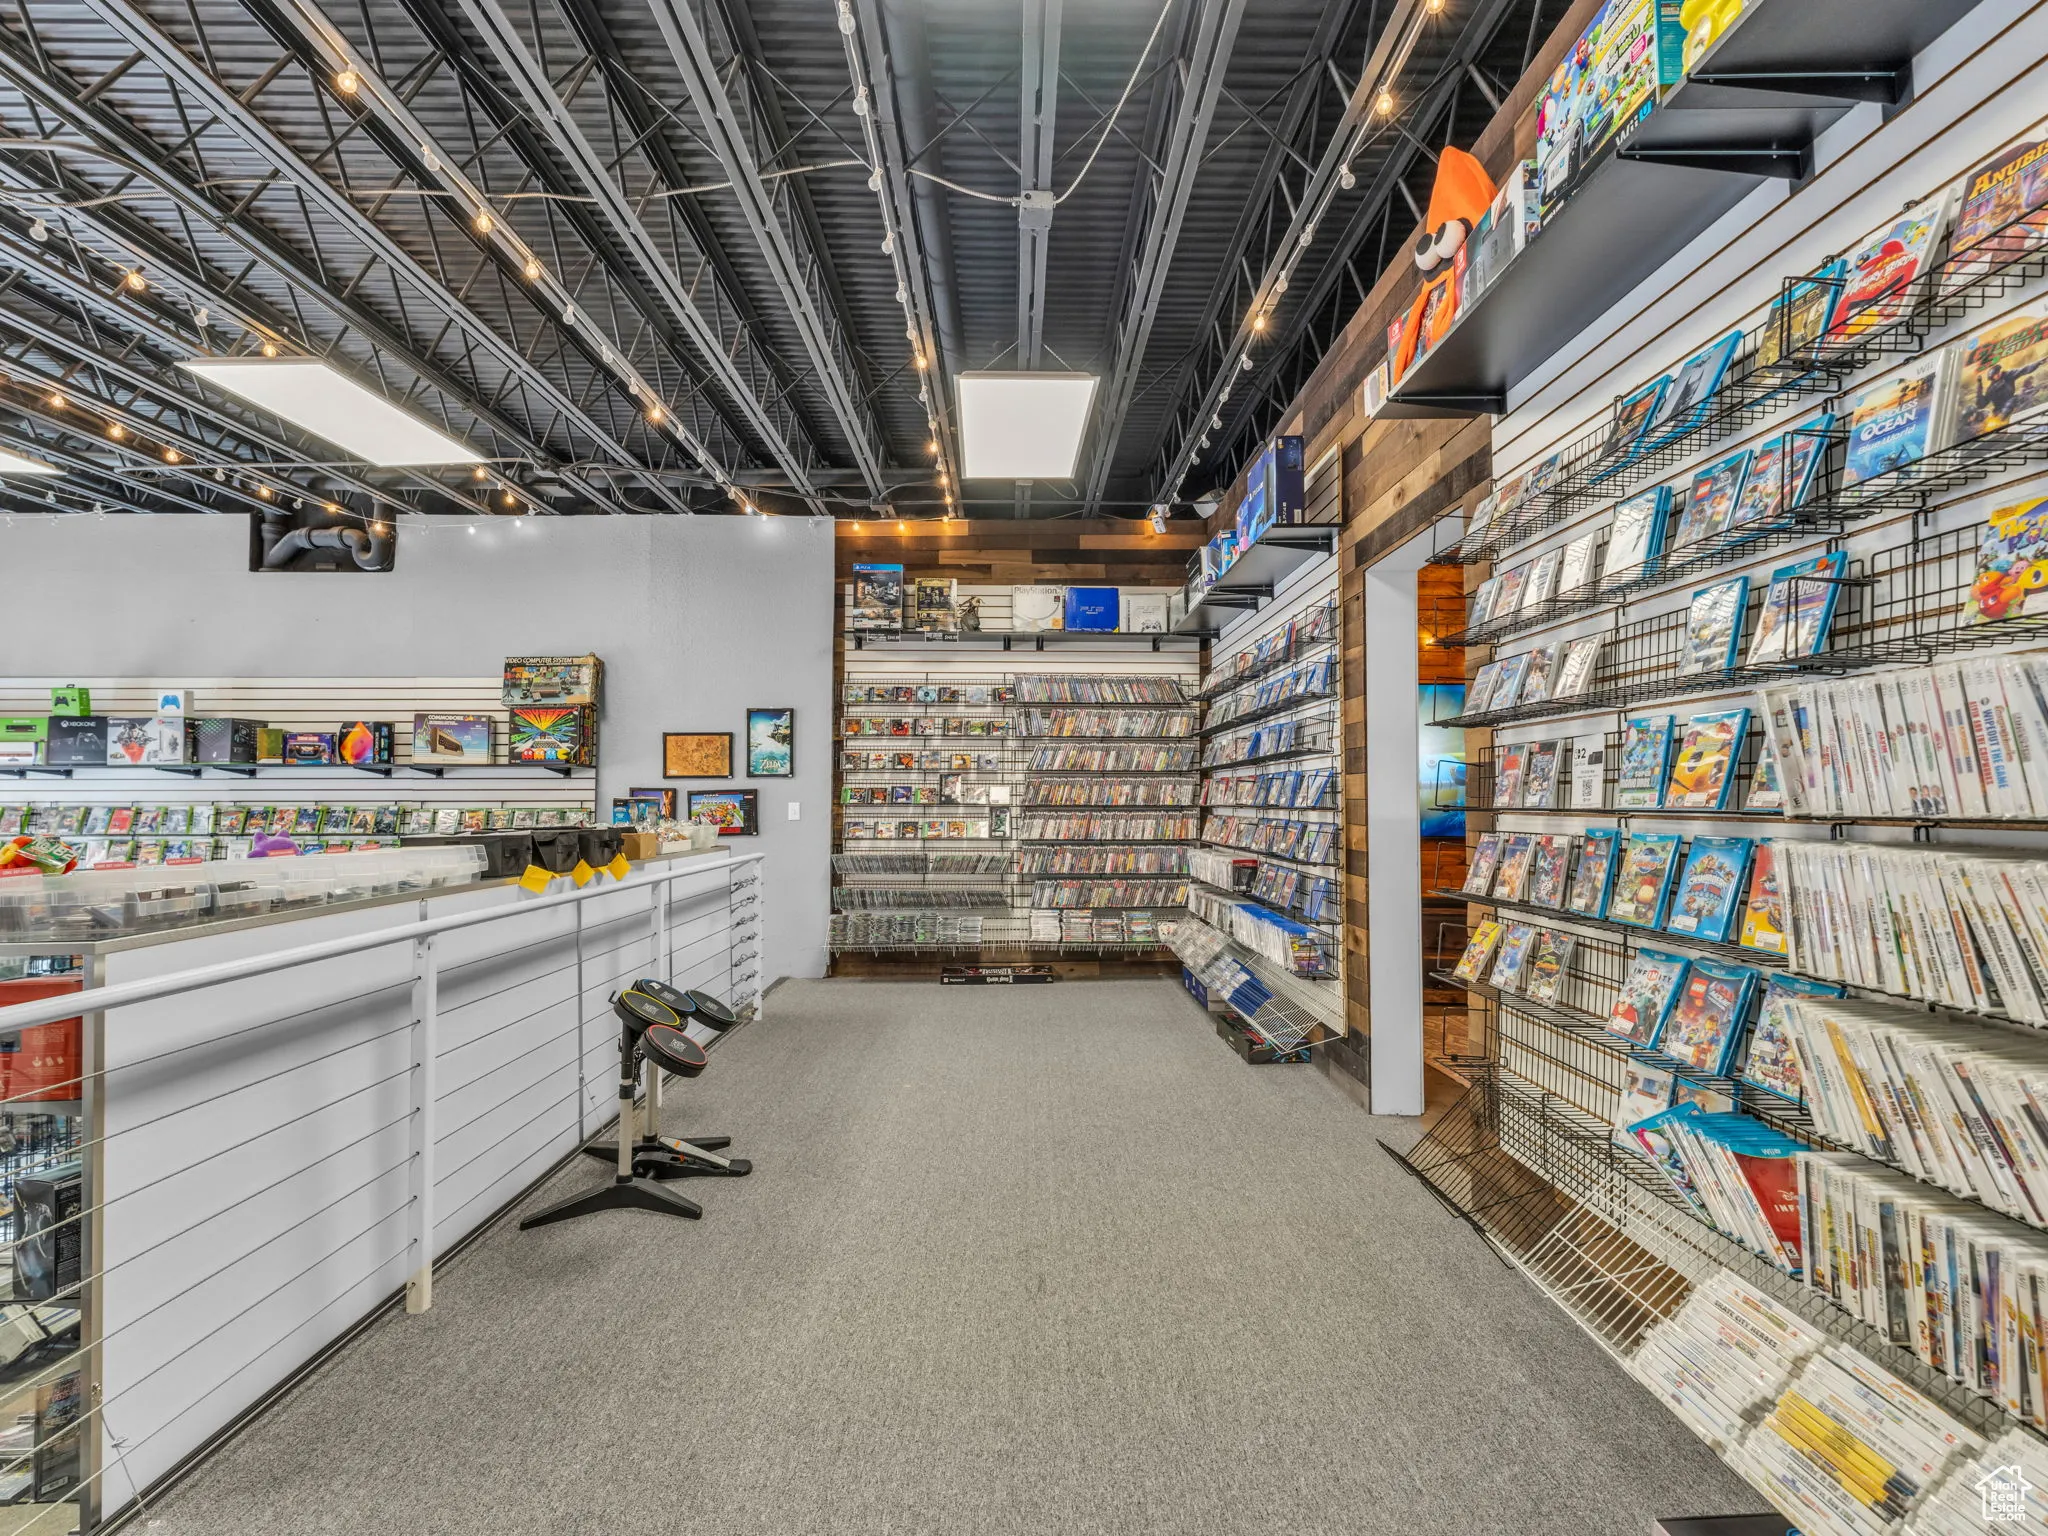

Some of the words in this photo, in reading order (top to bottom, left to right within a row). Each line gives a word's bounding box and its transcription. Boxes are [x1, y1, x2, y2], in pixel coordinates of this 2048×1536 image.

[1615, 115, 1639, 147] Wii
[1860, 408, 1917, 442] OCEAN
[1014, 586, 1057, 595] PlayStation
[1982, 709, 2000, 746] WIPEOUT
[760, 759, 782, 770] ZELDA
[1991, 747, 2003, 762] THE
[1995, 764, 2009, 789] GAME
[2021, 938, 2038, 970] MONSTER
[1888, 1100, 1899, 1117] MAN
[1906, 1106, 1918, 1123] MAN
[1973, 1117, 1987, 1135] JUST
[1983, 1134, 2002, 1160] DANCE
[1939, 1280, 1950, 1316] NCIS
[1714, 1300, 1734, 1318] SKATE
[1734, 1314, 1749, 1330] CITY
[1750, 1327, 1778, 1348] HEROES
